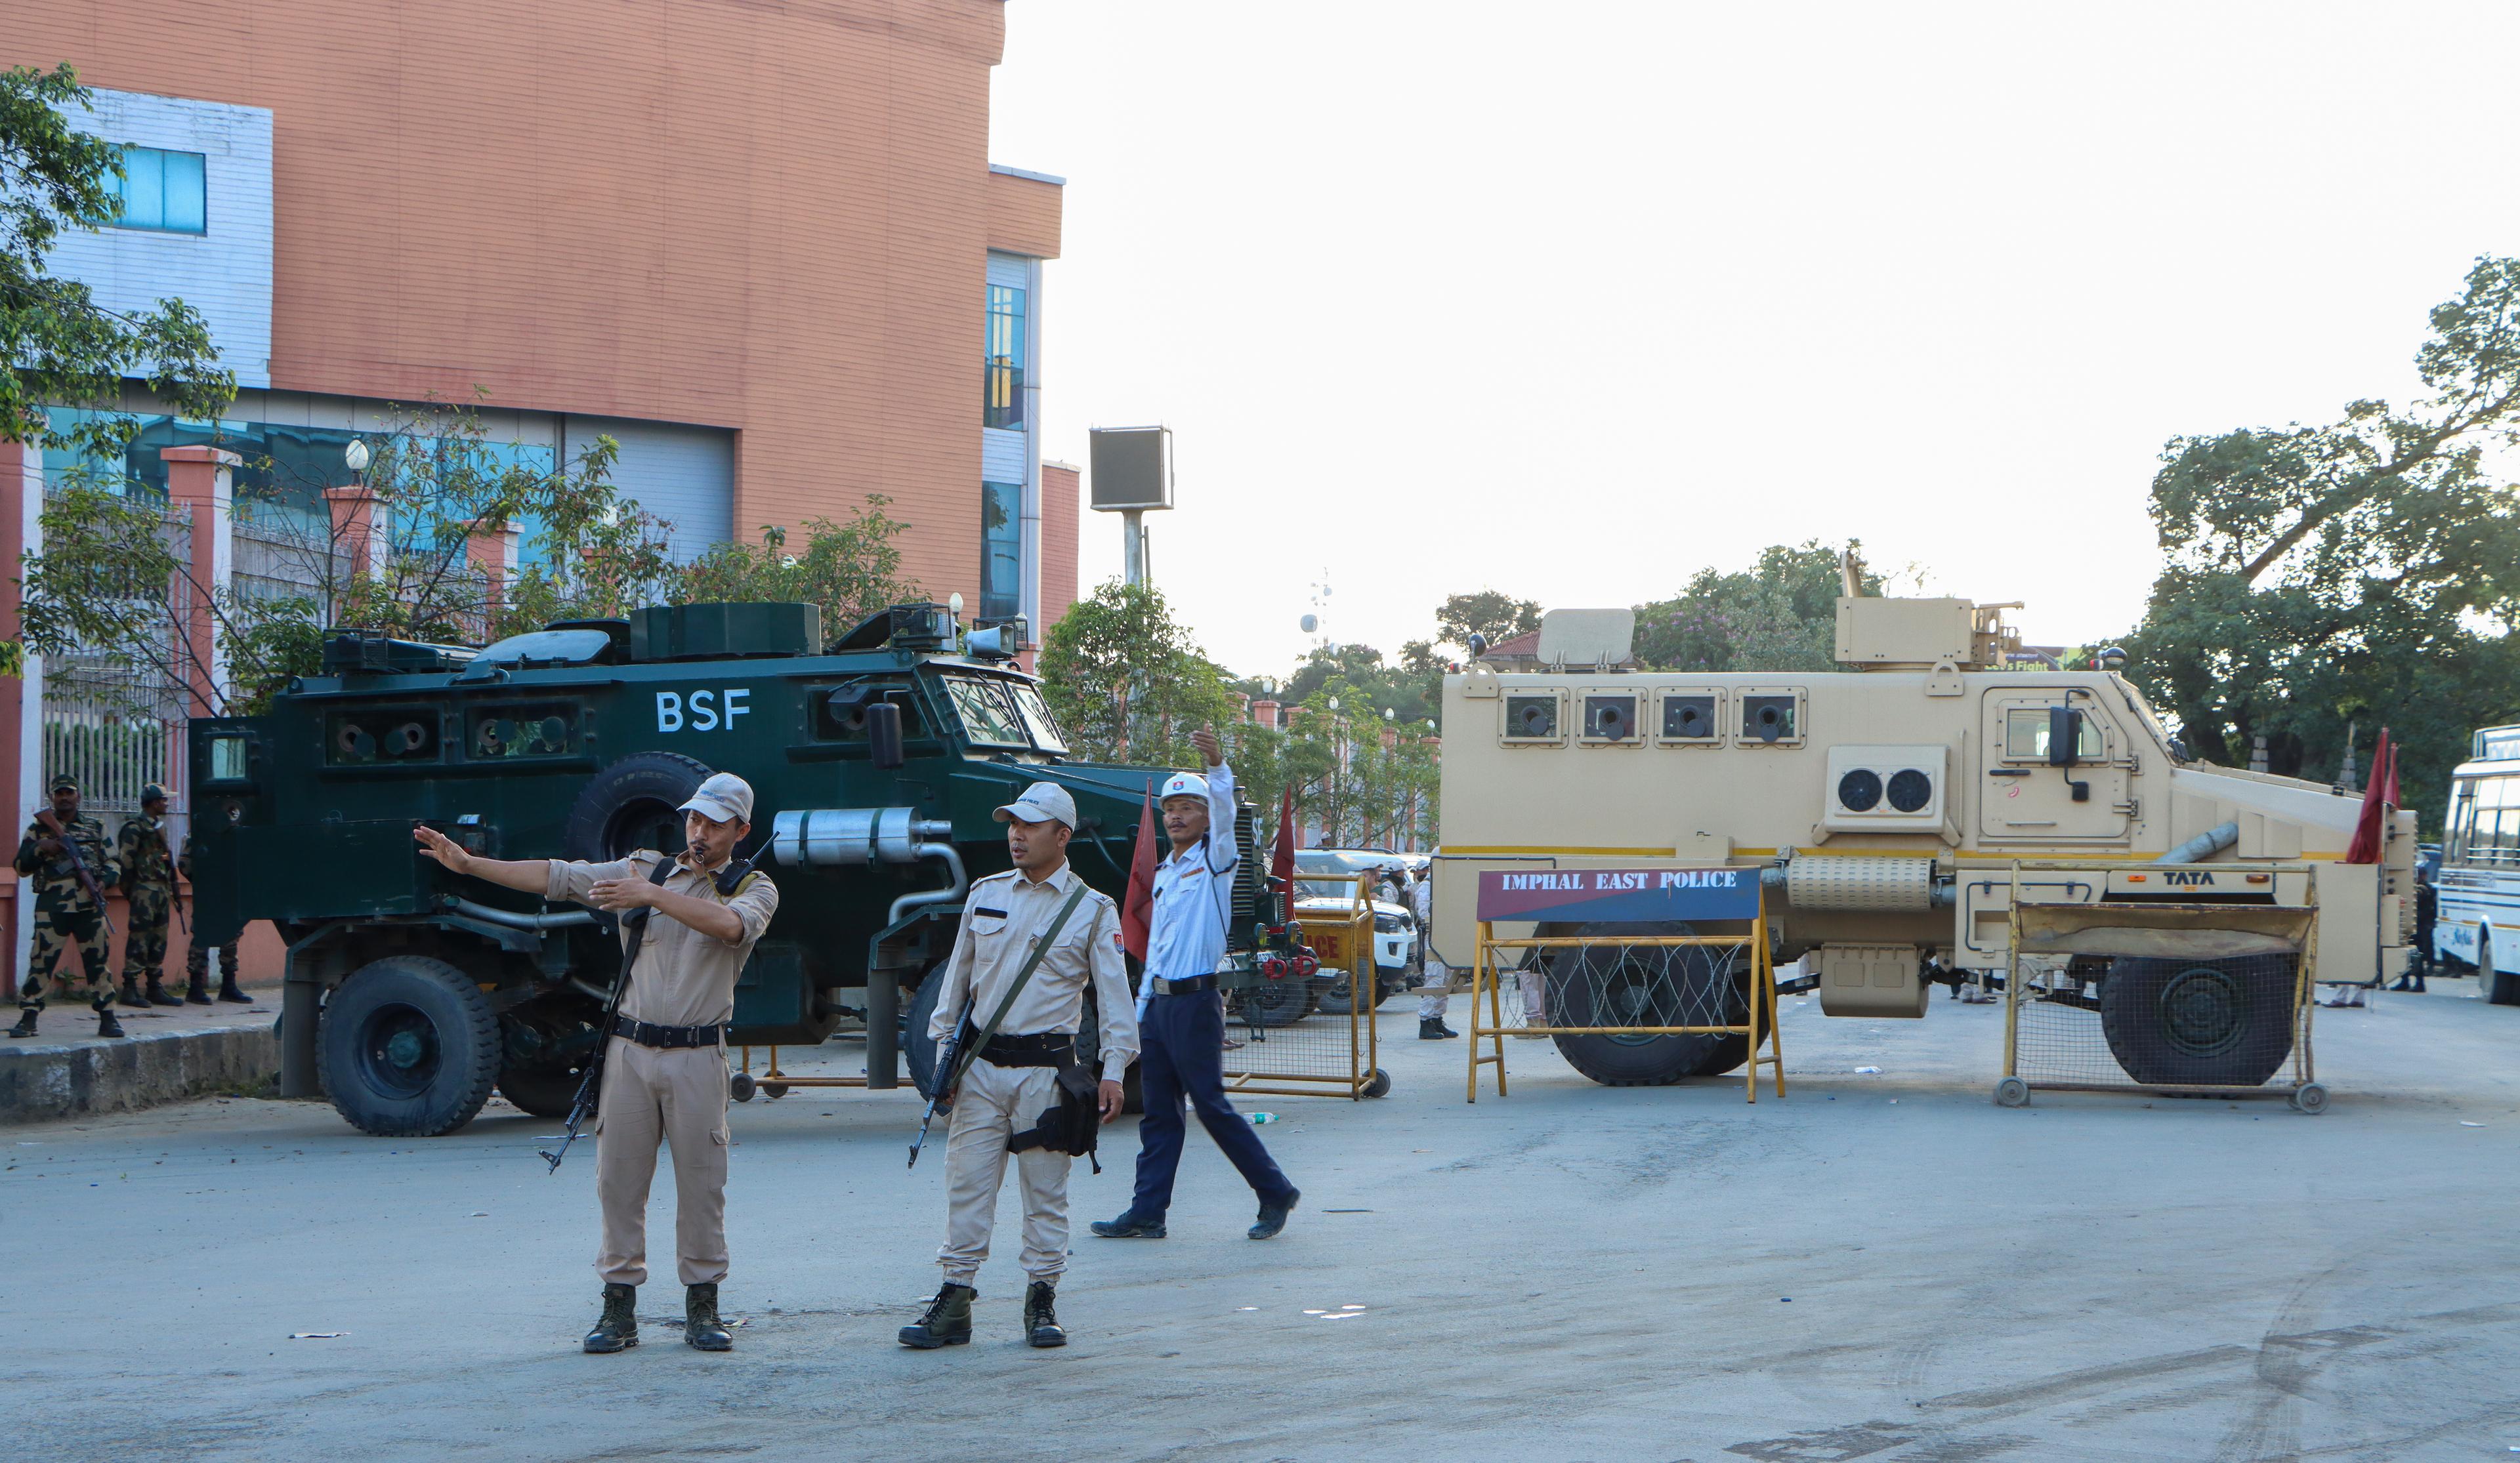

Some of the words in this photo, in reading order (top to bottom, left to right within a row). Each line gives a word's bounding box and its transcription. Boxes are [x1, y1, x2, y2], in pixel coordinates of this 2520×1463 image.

[2016, 660, 2049, 671] Fight
[656, 688, 750, 732] BSF
[1502, 874, 1584, 890] IMPHAL
[1595, 873, 1648, 890] EAST
[1660, 871, 1736, 888] POLICE
[2164, 872, 2215, 885] TATA
